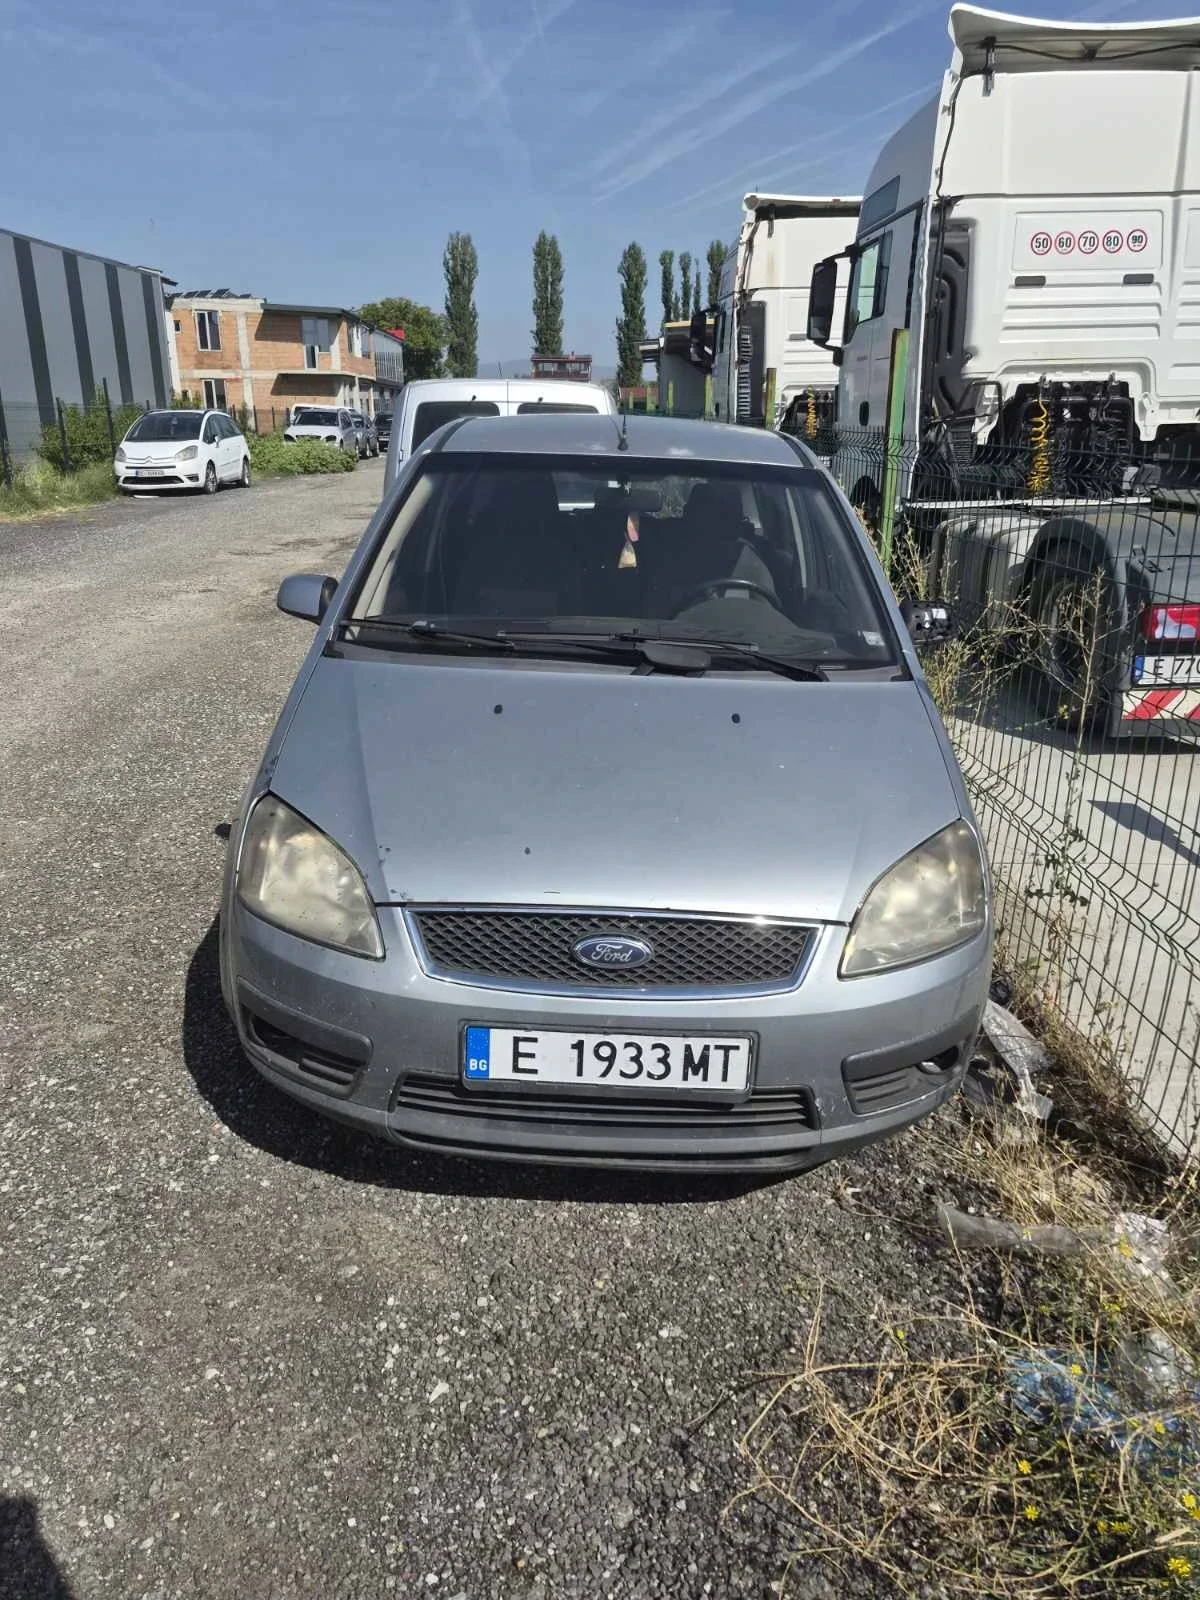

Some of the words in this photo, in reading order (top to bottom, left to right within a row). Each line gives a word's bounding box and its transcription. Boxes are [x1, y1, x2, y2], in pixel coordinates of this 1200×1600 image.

[1035, 237, 1049, 249] 50
[1058, 236, 1072, 248] 60
[1082, 236, 1096, 248] 70
[1106, 235, 1120, 247] 80
[1131, 234, 1144, 244] 90
[1153, 658, 1165, 675] E
[591, 943, 633, 962] Ford
[512, 1036, 539, 1075] E
[469, 1058, 488, 1071] BG
